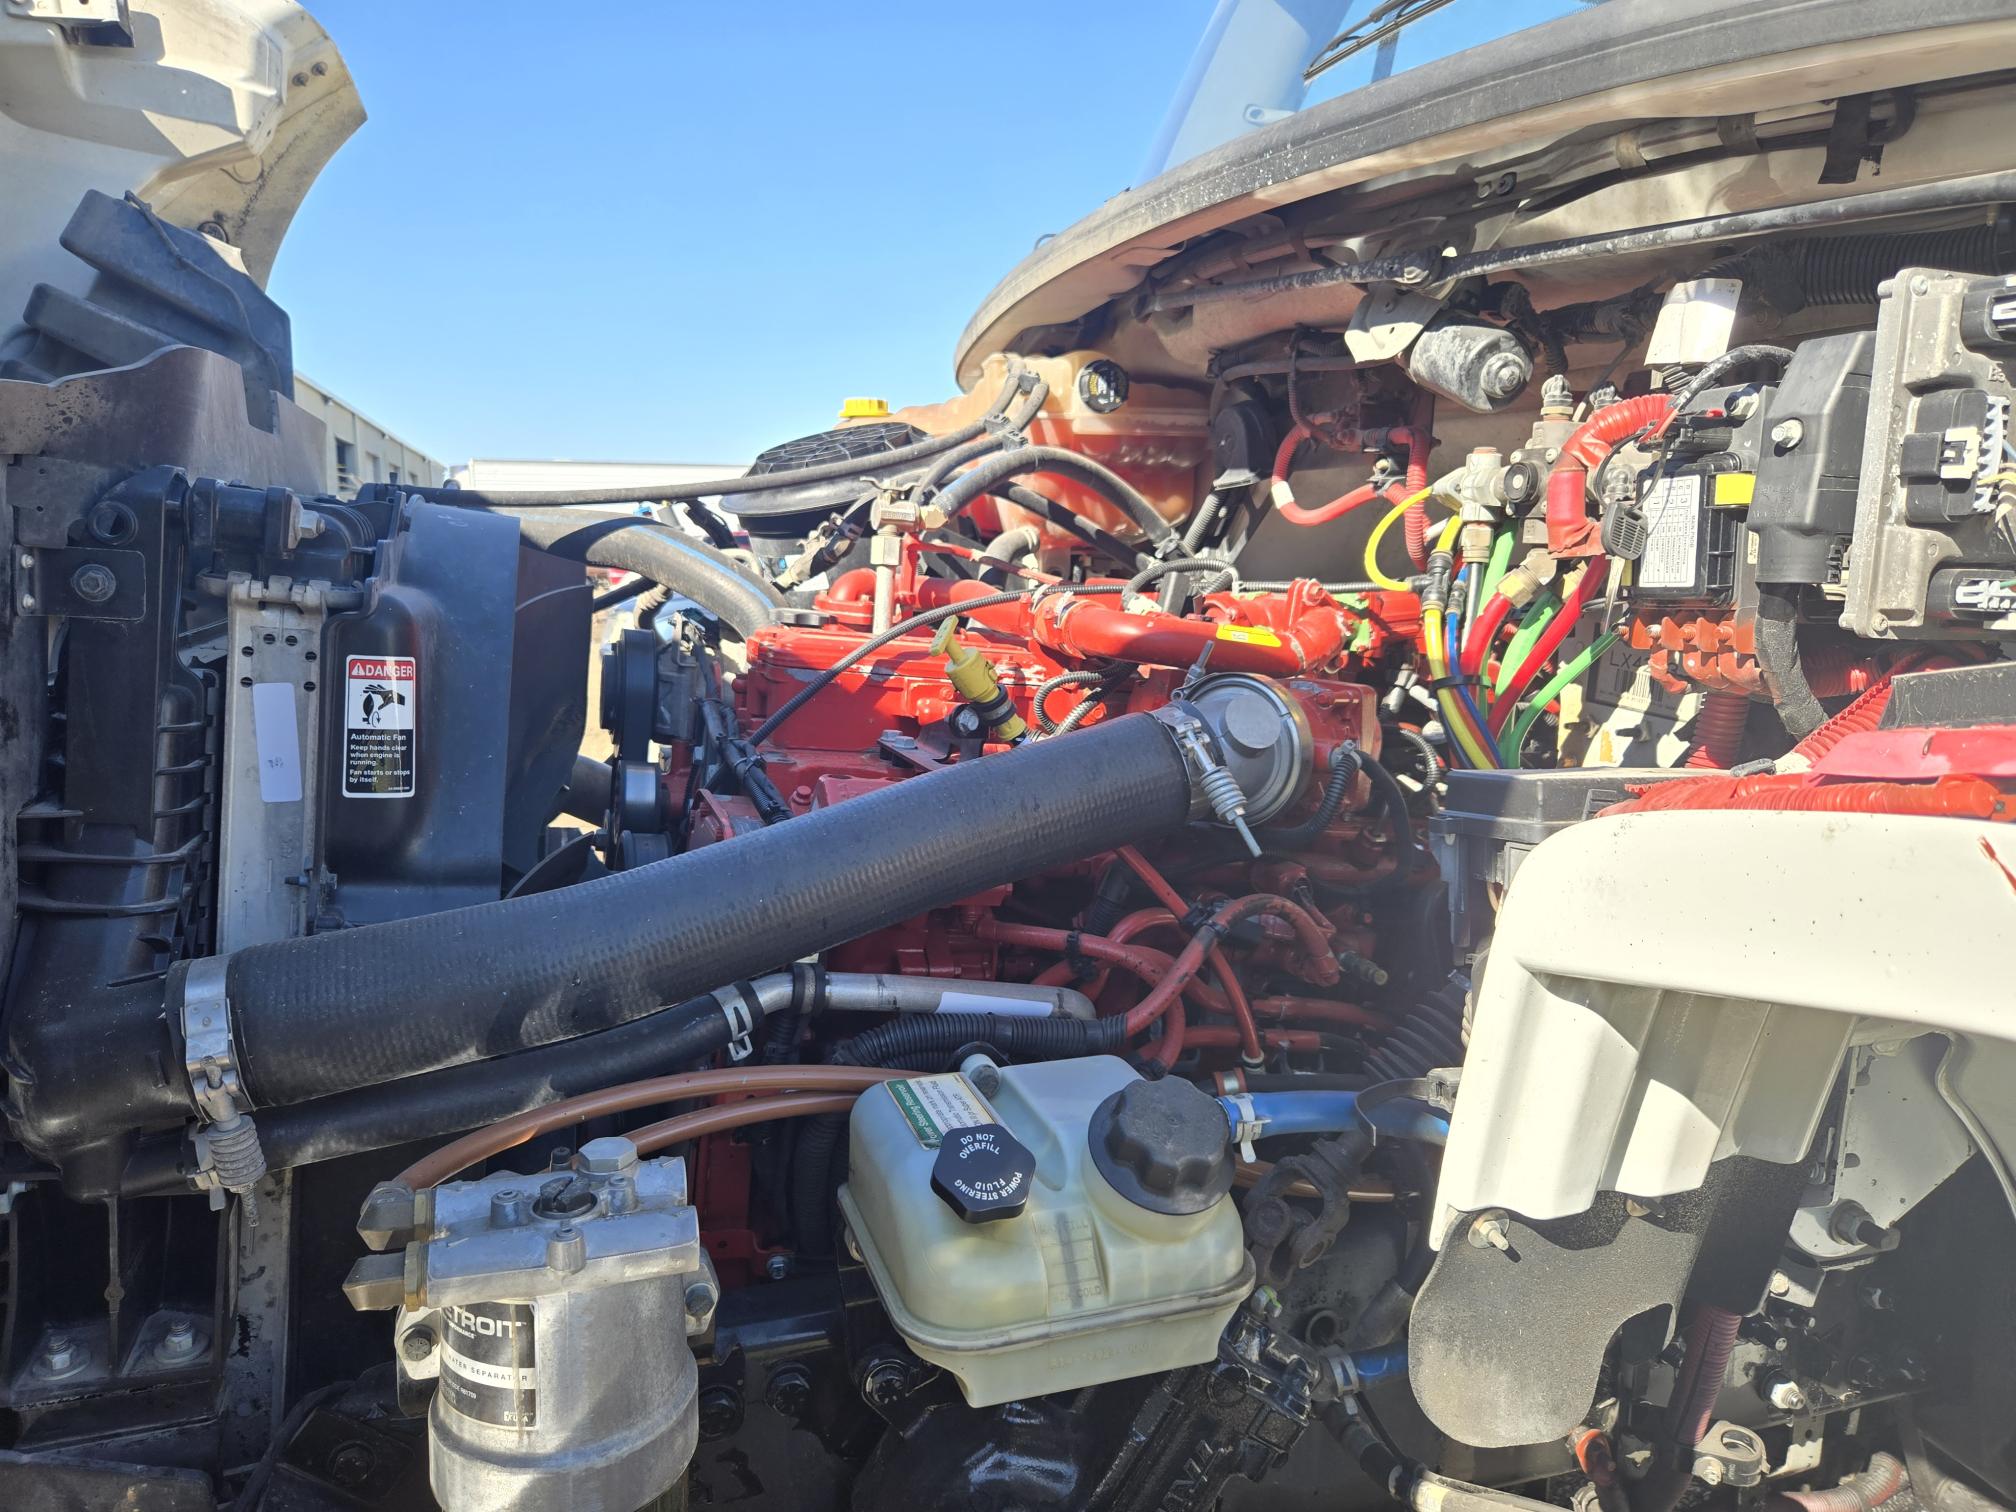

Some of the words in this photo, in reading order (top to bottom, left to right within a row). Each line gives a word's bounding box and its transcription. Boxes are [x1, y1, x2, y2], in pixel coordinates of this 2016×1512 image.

[365, 664, 413, 678] DANGER
[350, 733, 391, 742] Automatic
[393, 733, 407, 742] Fan
[350, 744, 368, 752] Keep
[369, 744, 390, 752] hands
[391, 744, 407, 752] clear
[370, 752, 393, 760] engine
[393, 769, 411, 777] stops
[349, 776, 358, 784] by
[959, 1135, 973, 1145] DO
[976, 1133, 995, 1142] NOT
[959, 1142, 1000, 1160] OVERFILL
[954, 1179, 999, 1201] STEERING
[974, 1178, 1006, 1190] FLUID
[1000, 1171, 1023, 1198] POWER
[471, 1367, 528, 1382] SEPARATR
